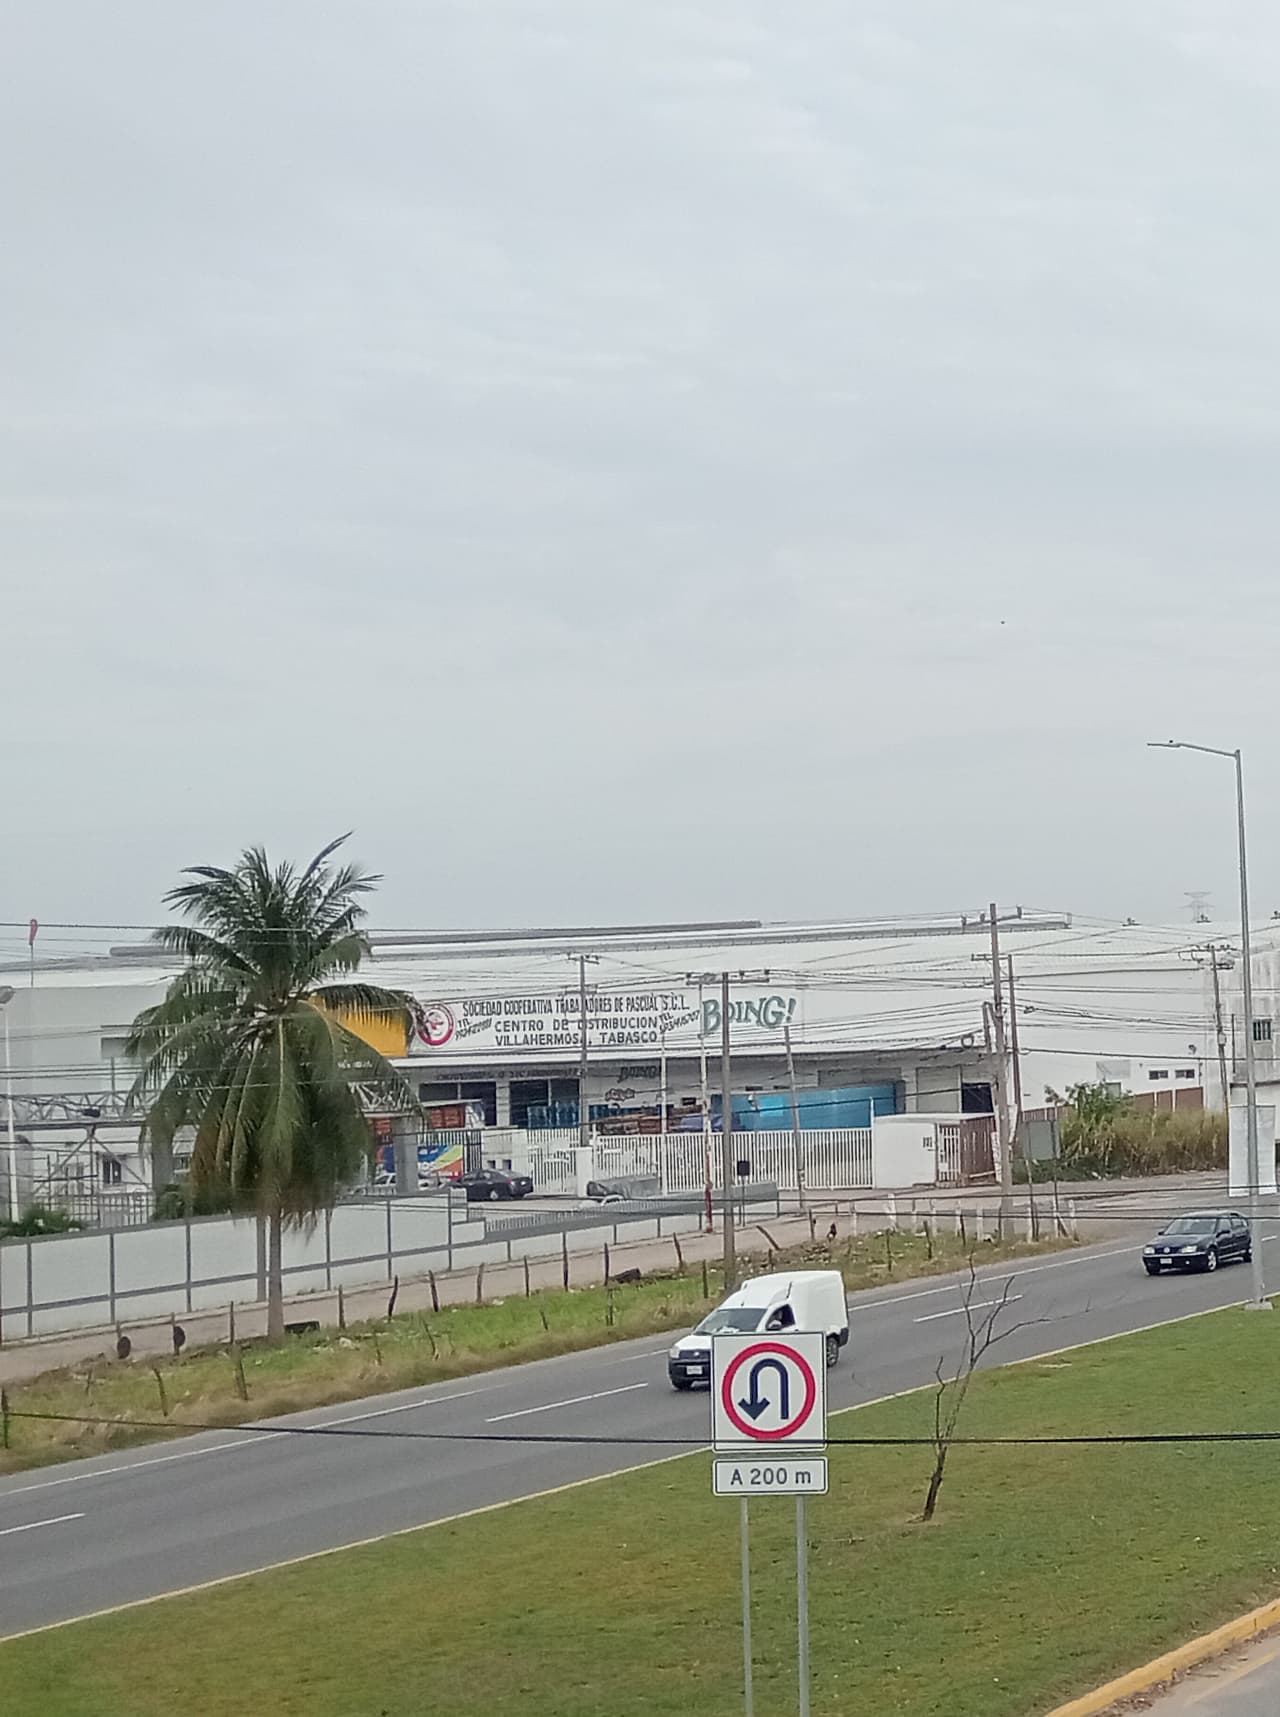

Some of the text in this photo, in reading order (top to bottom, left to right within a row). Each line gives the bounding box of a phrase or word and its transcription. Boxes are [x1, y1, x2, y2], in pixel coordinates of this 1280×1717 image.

[463, 1000, 500, 1017] SOCIEDAD
[504, 999, 552, 1016] COOPERATIVA
[555, 997, 611, 1013] TRABAADORES
[614, 997, 624, 1012] DE
[626, 995, 658, 1012] PASCUAL
[702, 996, 796, 1034] BOING!
[495, 1019, 544, 1032] CENTRO
[553, 1019, 569, 1031] DE
[577, 1016, 657, 1030] DSTRIBUCION
[495, 1031, 657, 1046] VILLAHERMOS, TABASCO
[730, 1467, 811, 1485] A 200 m
